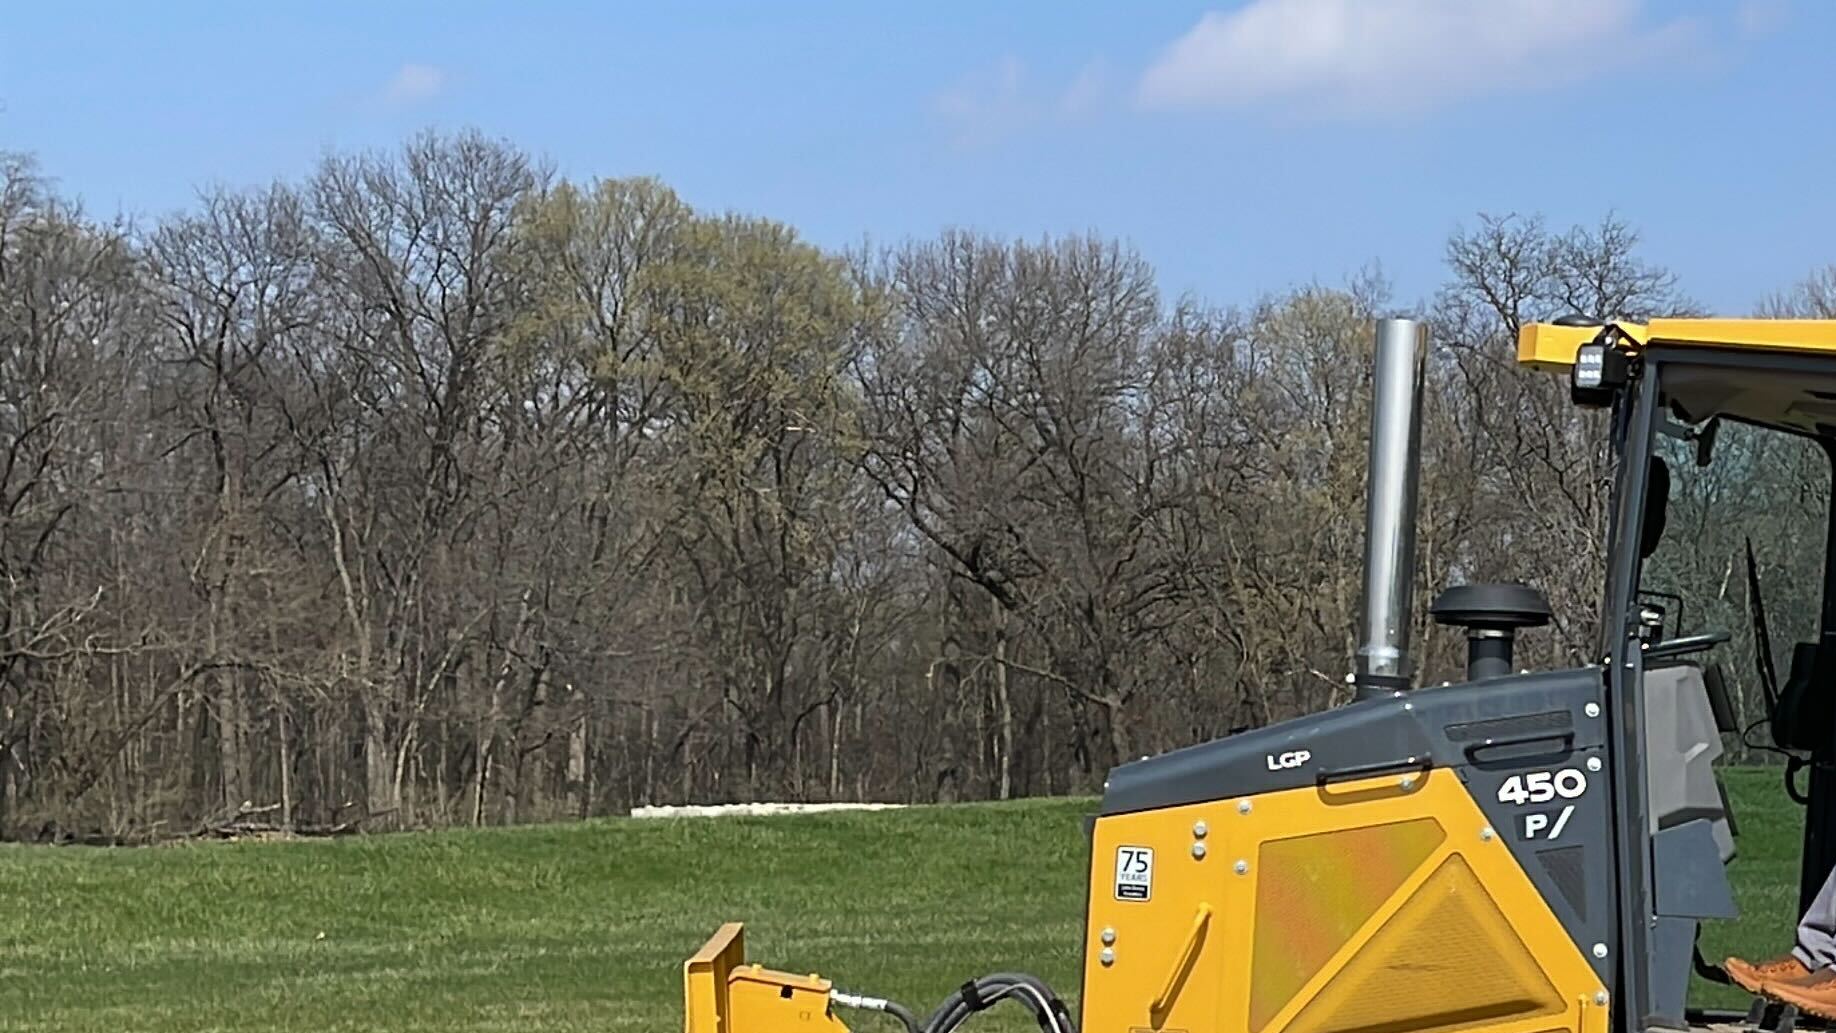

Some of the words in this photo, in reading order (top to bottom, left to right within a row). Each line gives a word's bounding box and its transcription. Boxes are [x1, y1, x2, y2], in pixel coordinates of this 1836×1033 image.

[1267, 750, 1311, 770] LGP
[1498, 768, 1587, 805] 450
[1121, 850, 1148, 873] 75
